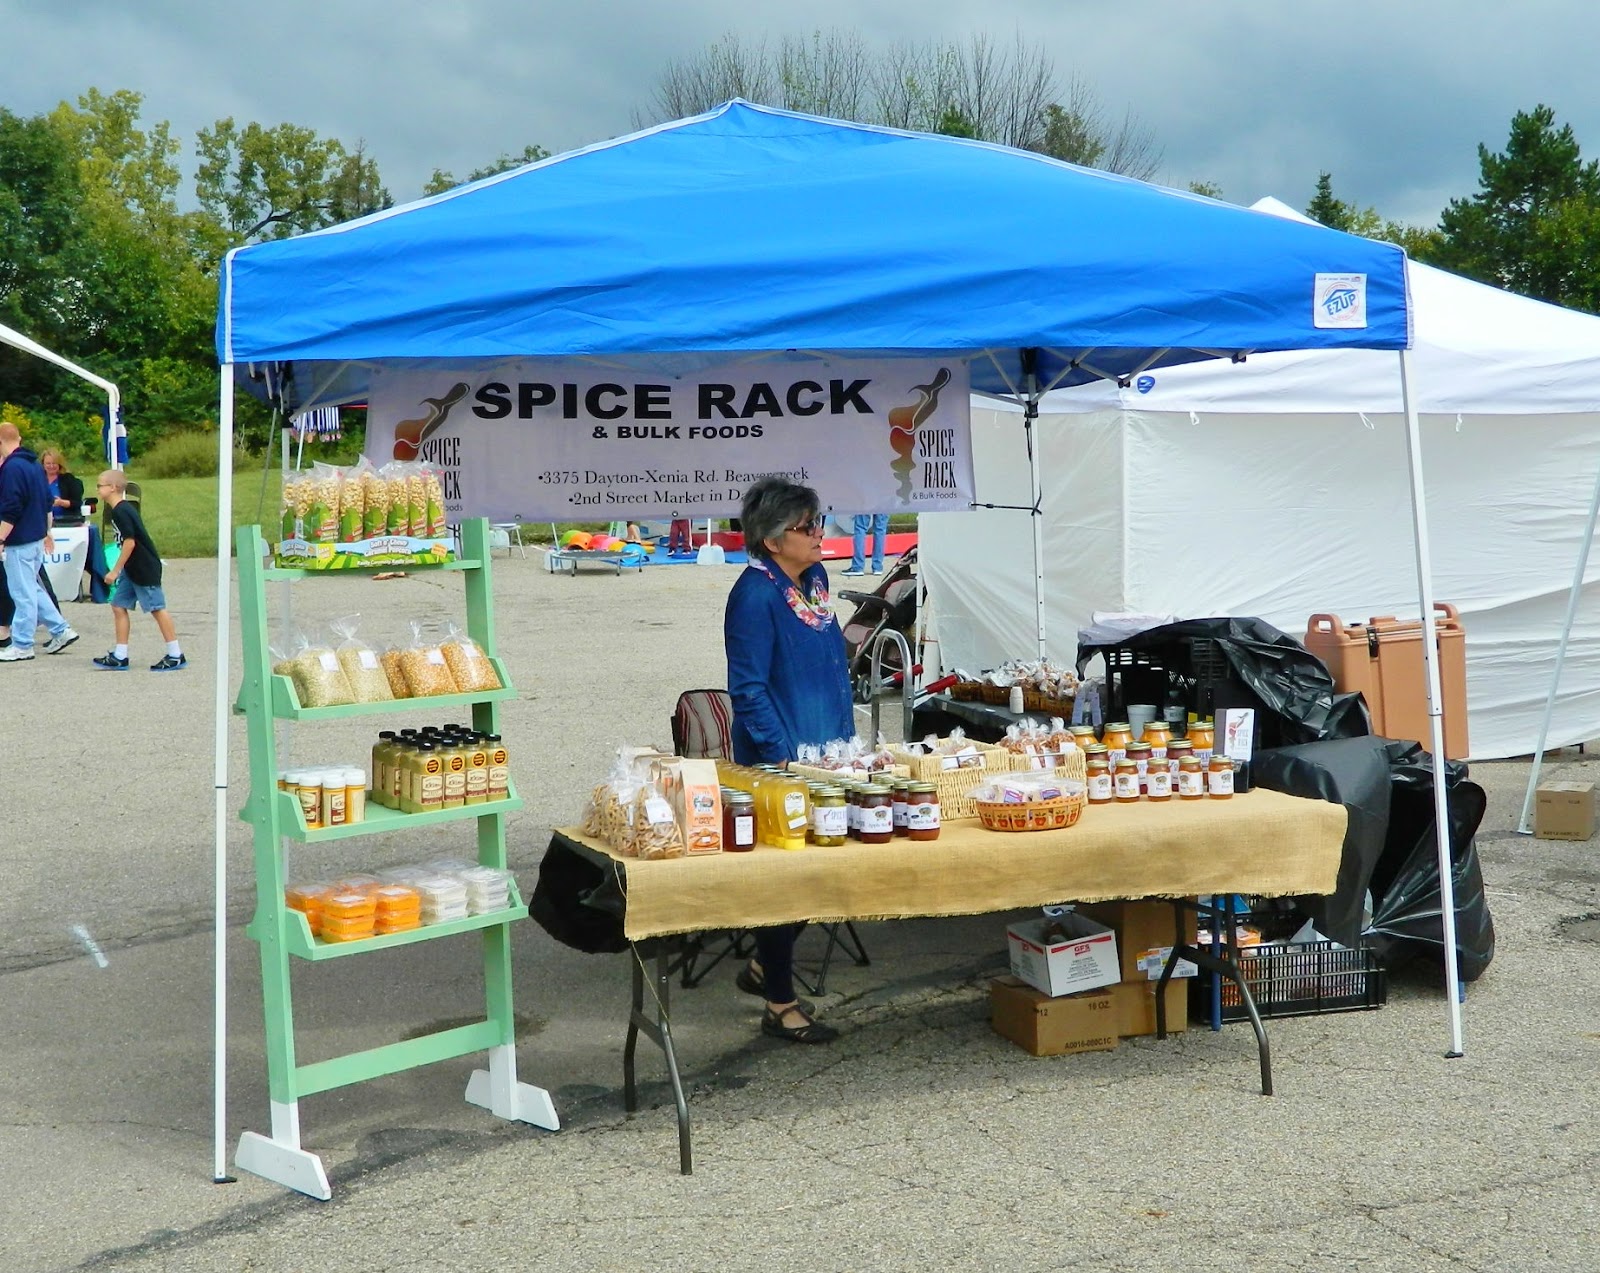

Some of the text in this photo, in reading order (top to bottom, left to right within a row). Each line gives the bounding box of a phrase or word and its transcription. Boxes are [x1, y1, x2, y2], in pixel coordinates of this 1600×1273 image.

[471, 379, 874, 420] SPICE RACK
[592, 424, 763, 439] & BULK FOODS
[920, 428, 955, 457] SPICE
[584, 469, 689, 487] Dayton-Xenia
[694, 469, 720, 483] Rd.
[923, 461, 957, 489] RACK
[444, 470, 462, 500] CK
[605, 491, 648, 504] Street
[653, 490, 705, 504] Market
[710, 489, 722, 502] in
[920, 491, 935, 499] Bulk
[936, 491, 957, 499] Foods
[43, 553, 71, 563] LUB
